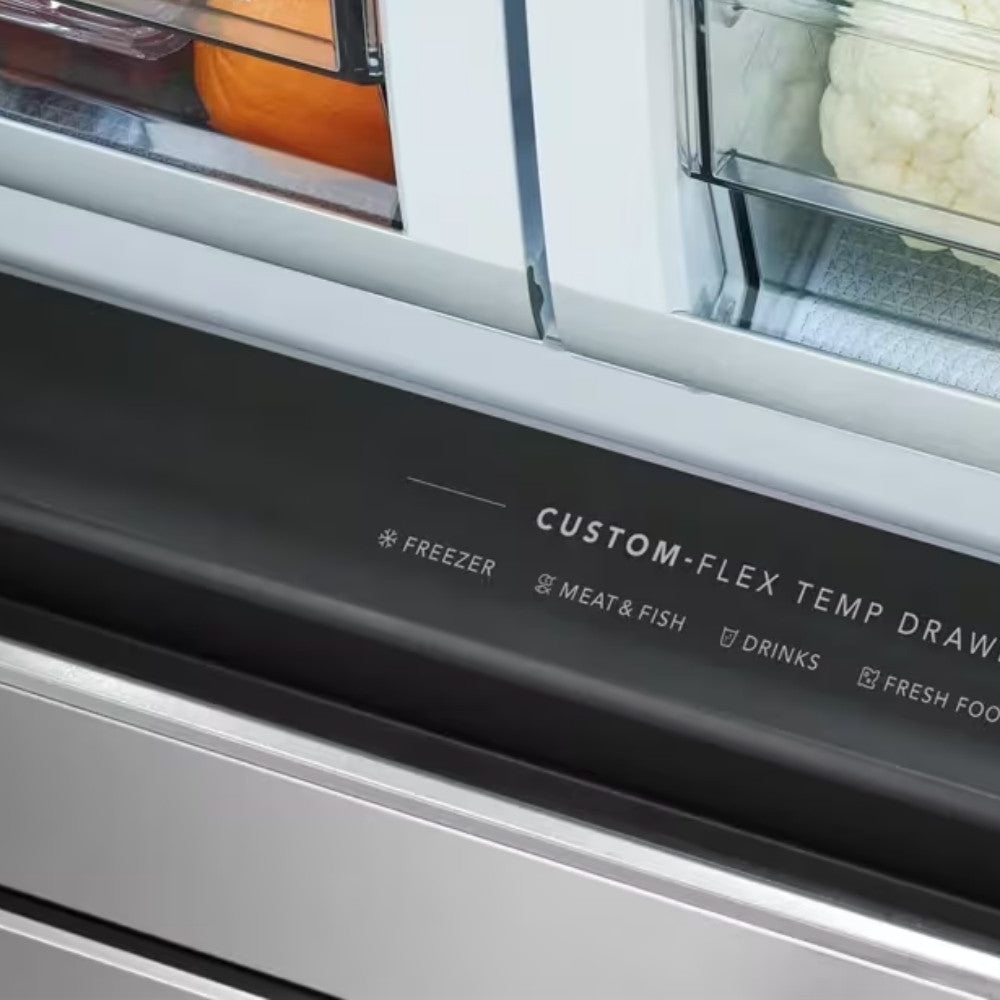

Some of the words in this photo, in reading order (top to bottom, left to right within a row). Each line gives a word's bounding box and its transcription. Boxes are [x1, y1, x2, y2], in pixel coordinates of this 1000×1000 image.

[402, 536, 497, 577] FREEZER
[536, 507, 780, 597] CUSTOM-FLEX
[797, 580, 884, 625] TEMP
[559, 581, 618, 612] MEAT
[618, 599, 633, 618] &
[638, 603, 687, 632] FISH
[742, 633, 821, 671] DRINKS
[883, 675, 950, 709] FRESH
